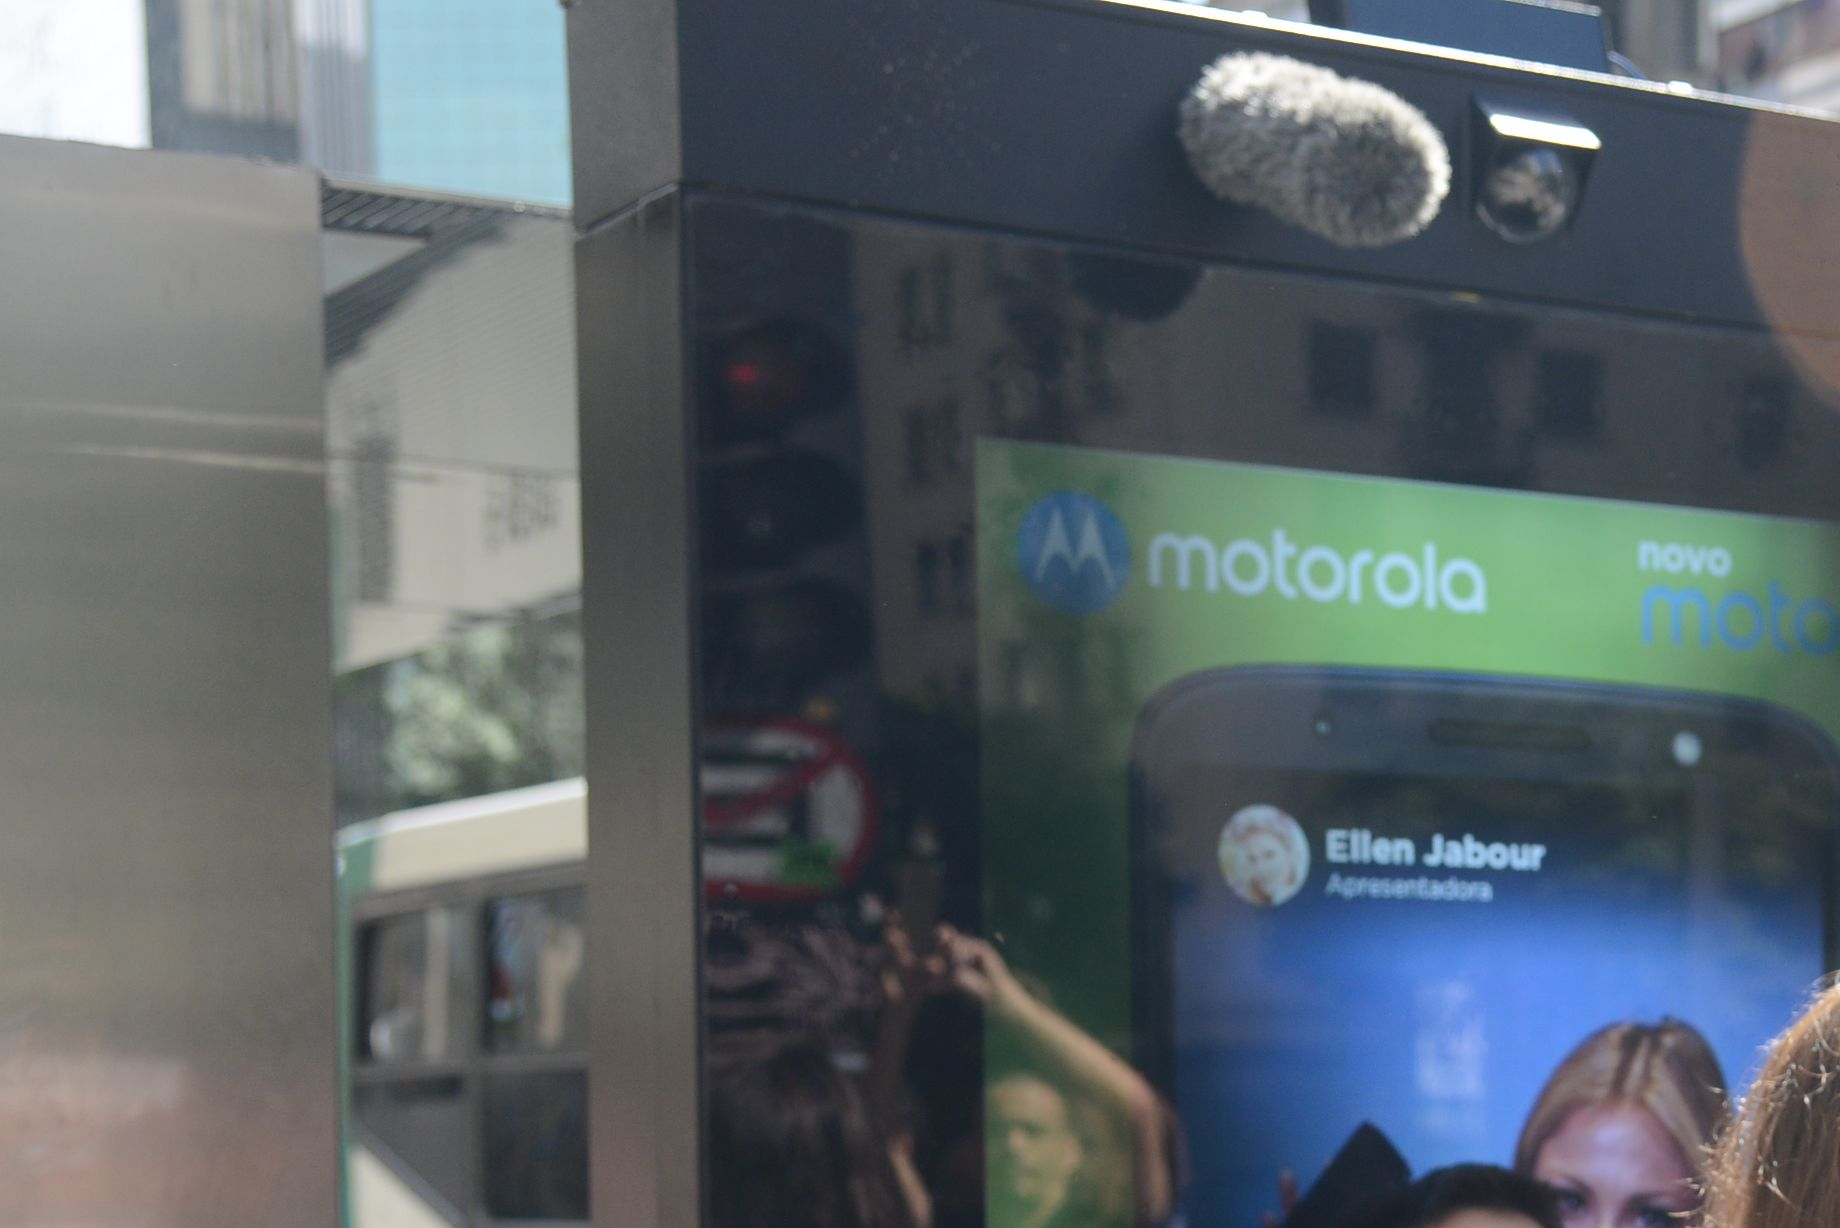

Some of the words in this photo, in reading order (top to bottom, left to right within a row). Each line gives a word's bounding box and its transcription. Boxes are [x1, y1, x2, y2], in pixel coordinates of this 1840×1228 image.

[1147, 529, 1487, 615] motorola
[1637, 540, 1732, 578] novo
[1325, 828, 1416, 866] Ellen
[1422, 833, 1547, 872] Jabour
[1325, 872, 1494, 903] Apresentadora
